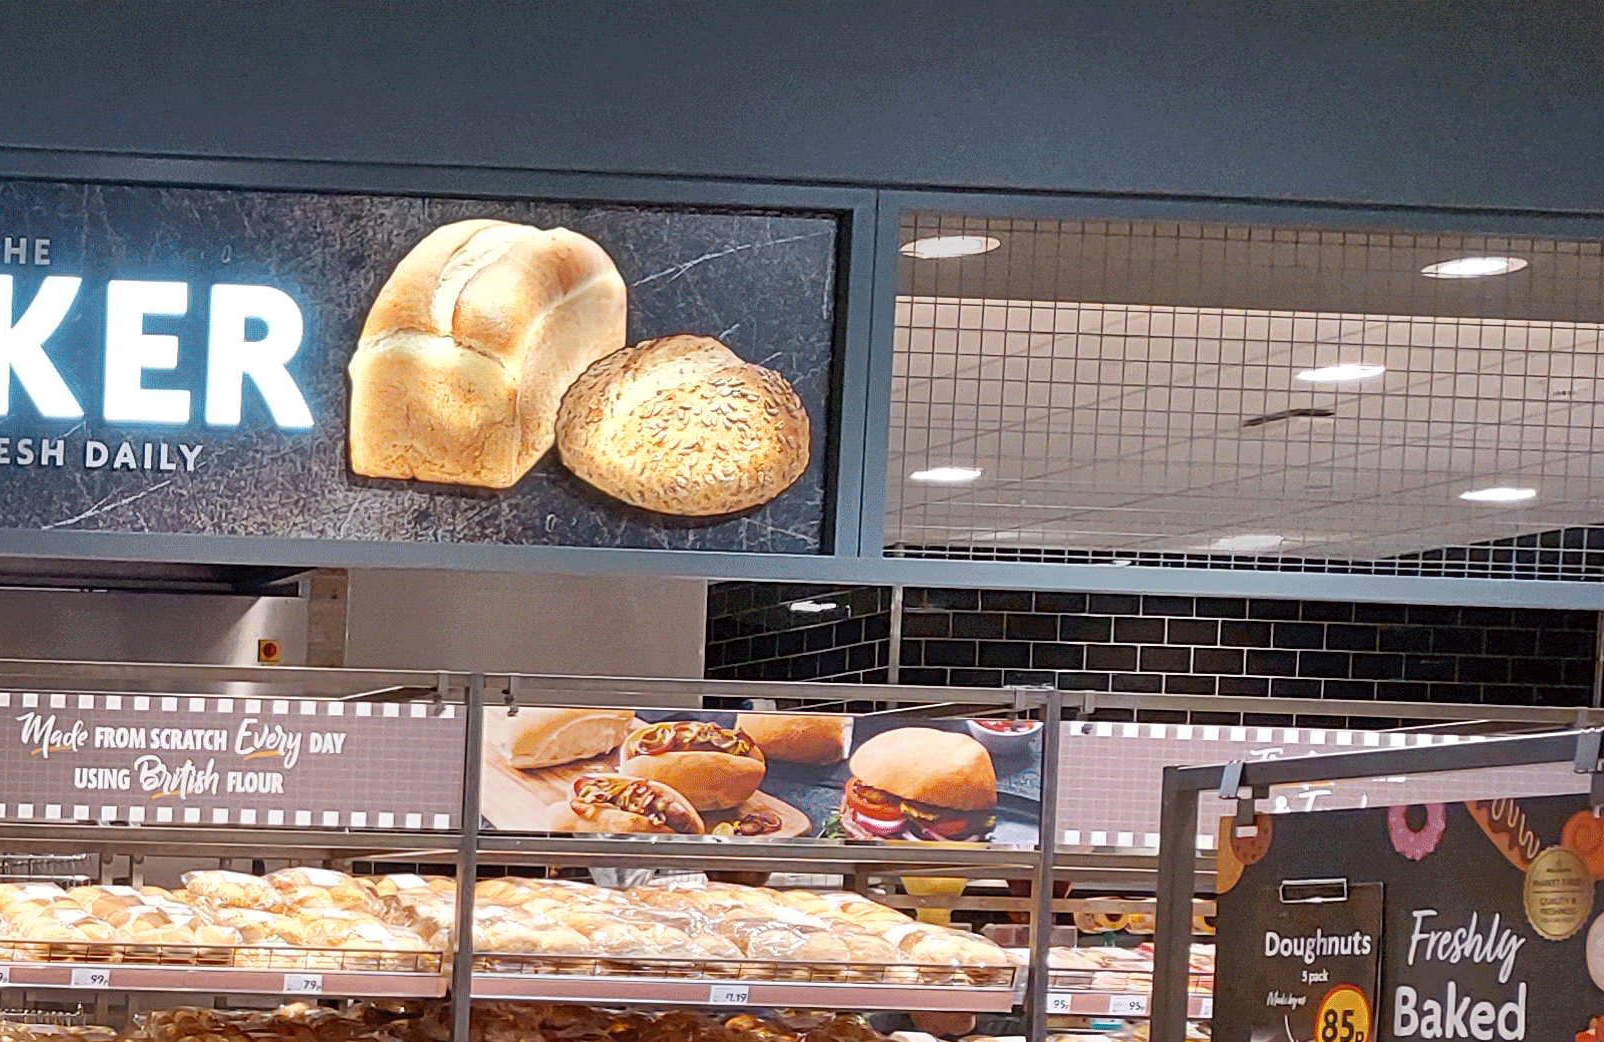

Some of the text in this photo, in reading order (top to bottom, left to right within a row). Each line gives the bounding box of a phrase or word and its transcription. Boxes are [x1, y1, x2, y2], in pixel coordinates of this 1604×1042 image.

[85, 440, 205, 473] DAILY
[16, 711, 347, 769] Made FROM SCRATCH Every DAY
[74, 754, 284, 799] USING British FLOUR
[1265, 928, 1372, 964] Doughnuts
[1407, 909, 1526, 983] Freshly
[304, 980, 321, 990] 79p
[1301, 970, 1308, 982] 5
[1393, 980, 1527, 1042] Baked
